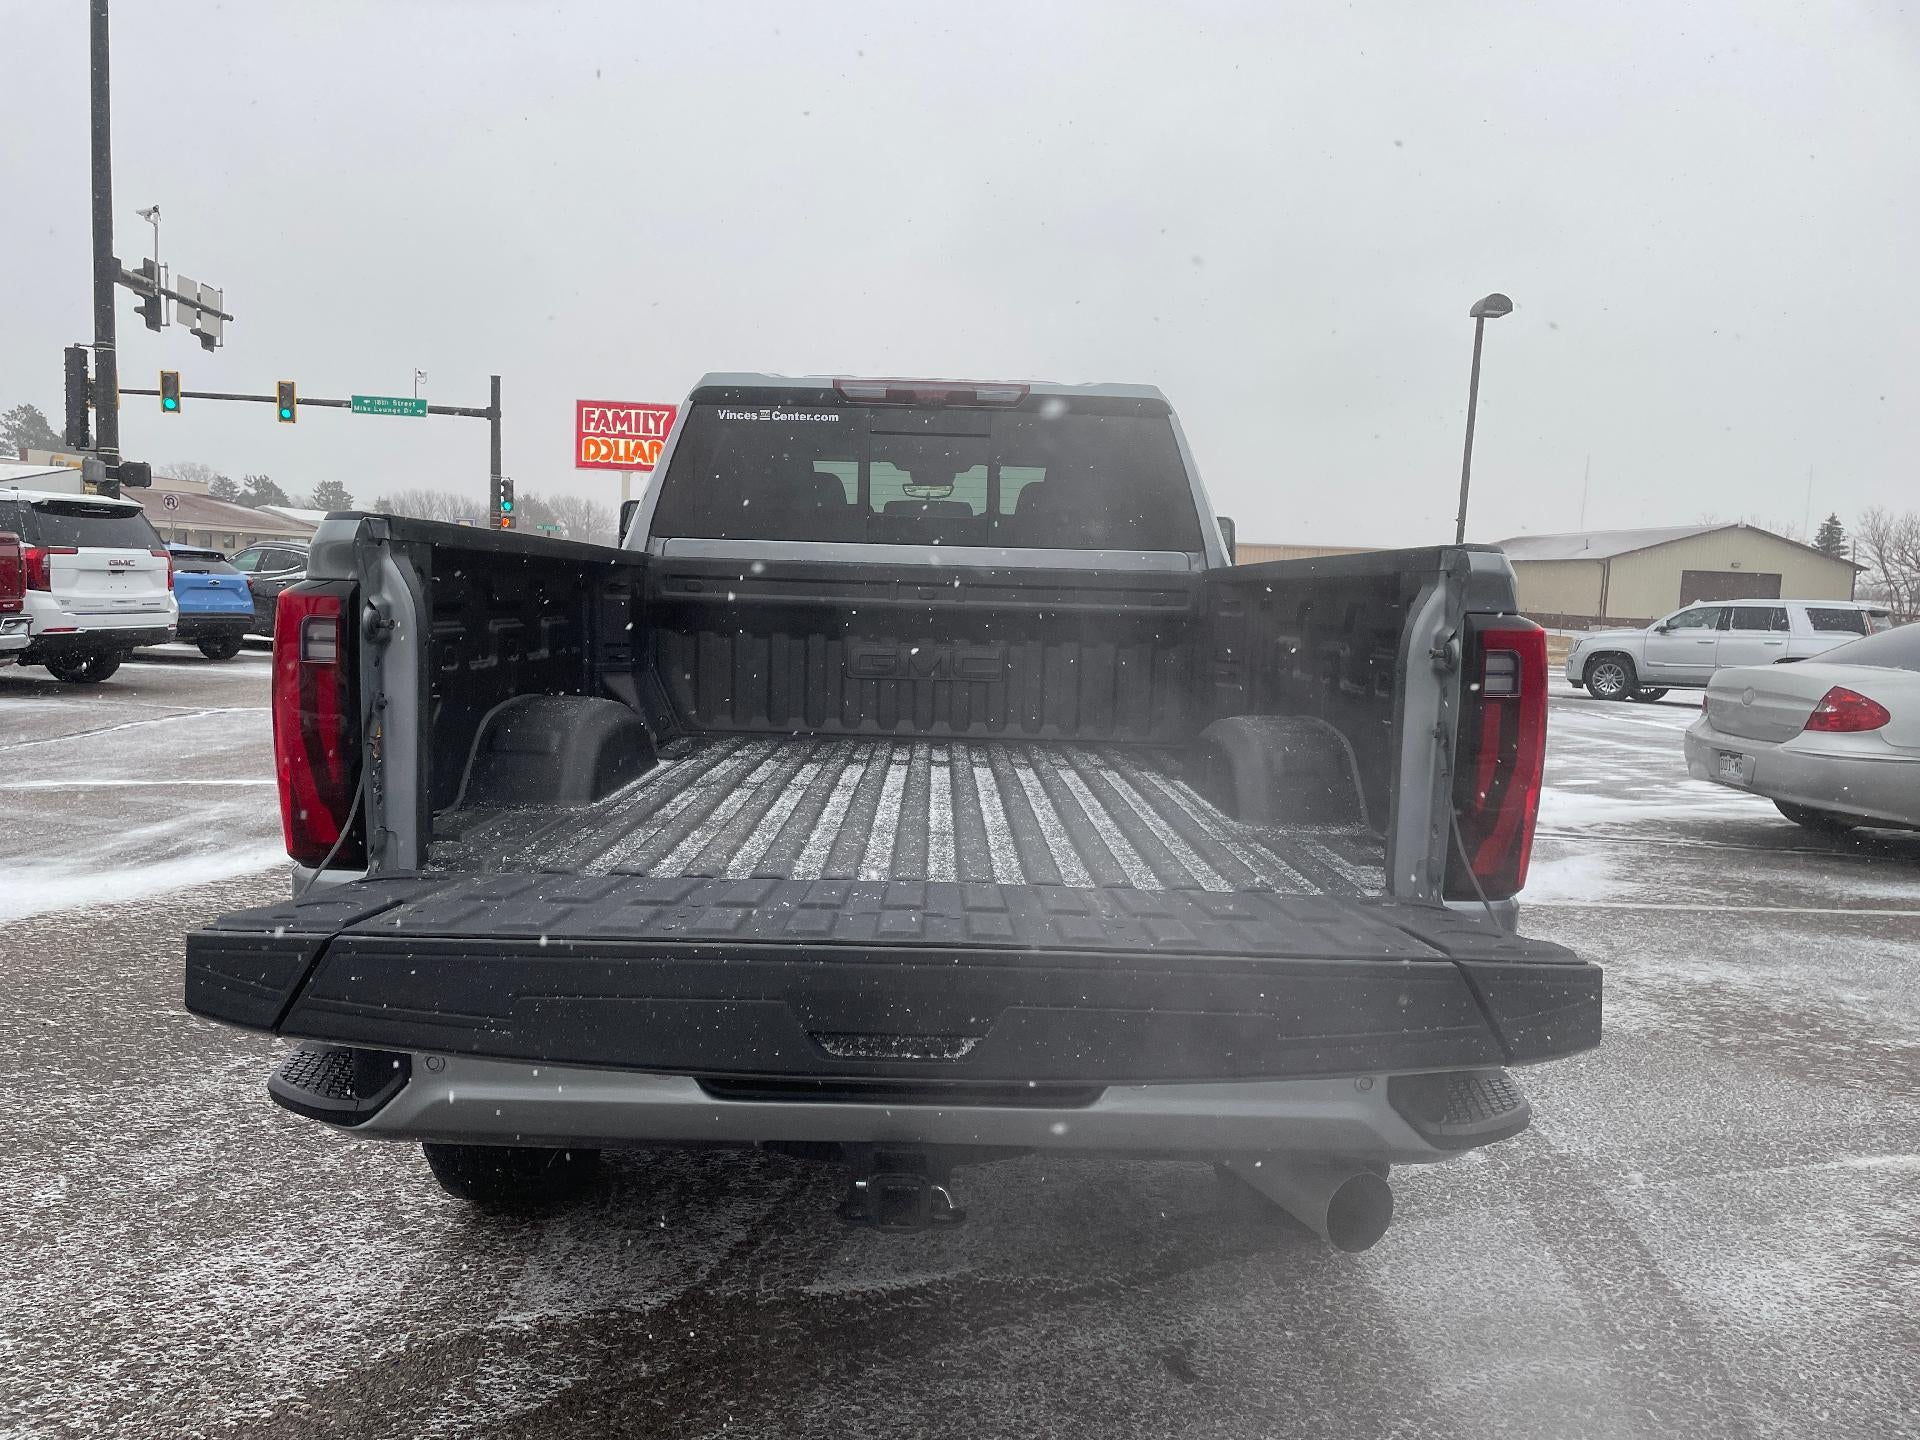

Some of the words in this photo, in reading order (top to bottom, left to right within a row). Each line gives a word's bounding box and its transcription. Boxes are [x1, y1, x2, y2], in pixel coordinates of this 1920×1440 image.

[374, 406, 401, 415] Lounge
[718, 409, 758, 420] Vinces
[772, 410, 840, 422] Center.com
[582, 408, 669, 436] FAMILY
[108, 559, 136, 567] GMC
[850, 645, 1002, 680] GMC
